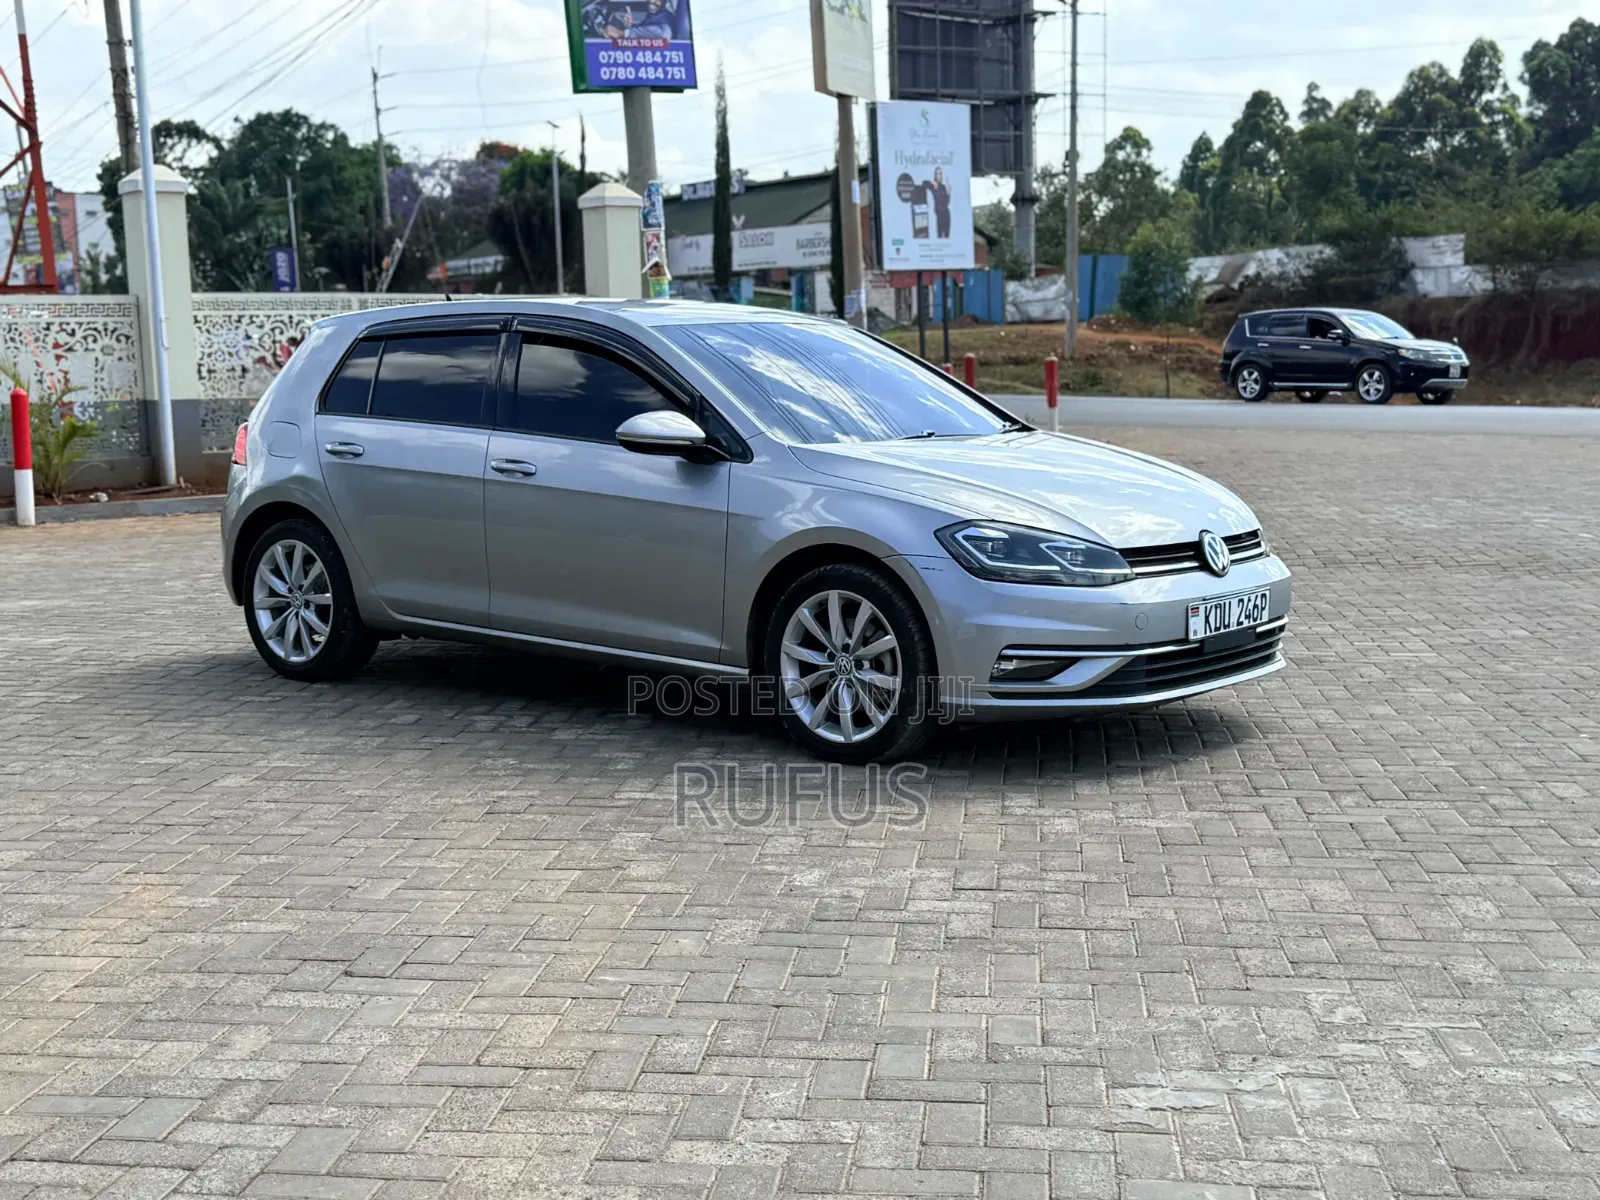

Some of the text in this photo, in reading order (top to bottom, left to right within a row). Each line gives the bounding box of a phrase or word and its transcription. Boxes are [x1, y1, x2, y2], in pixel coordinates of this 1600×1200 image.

[617, 39, 664, 47] TALK TO US
[599, 51, 684, 63] 0790 484 751
[600, 67, 686, 80] 0780 484 751
[1204, 592, 1268, 635] KDU 246P
